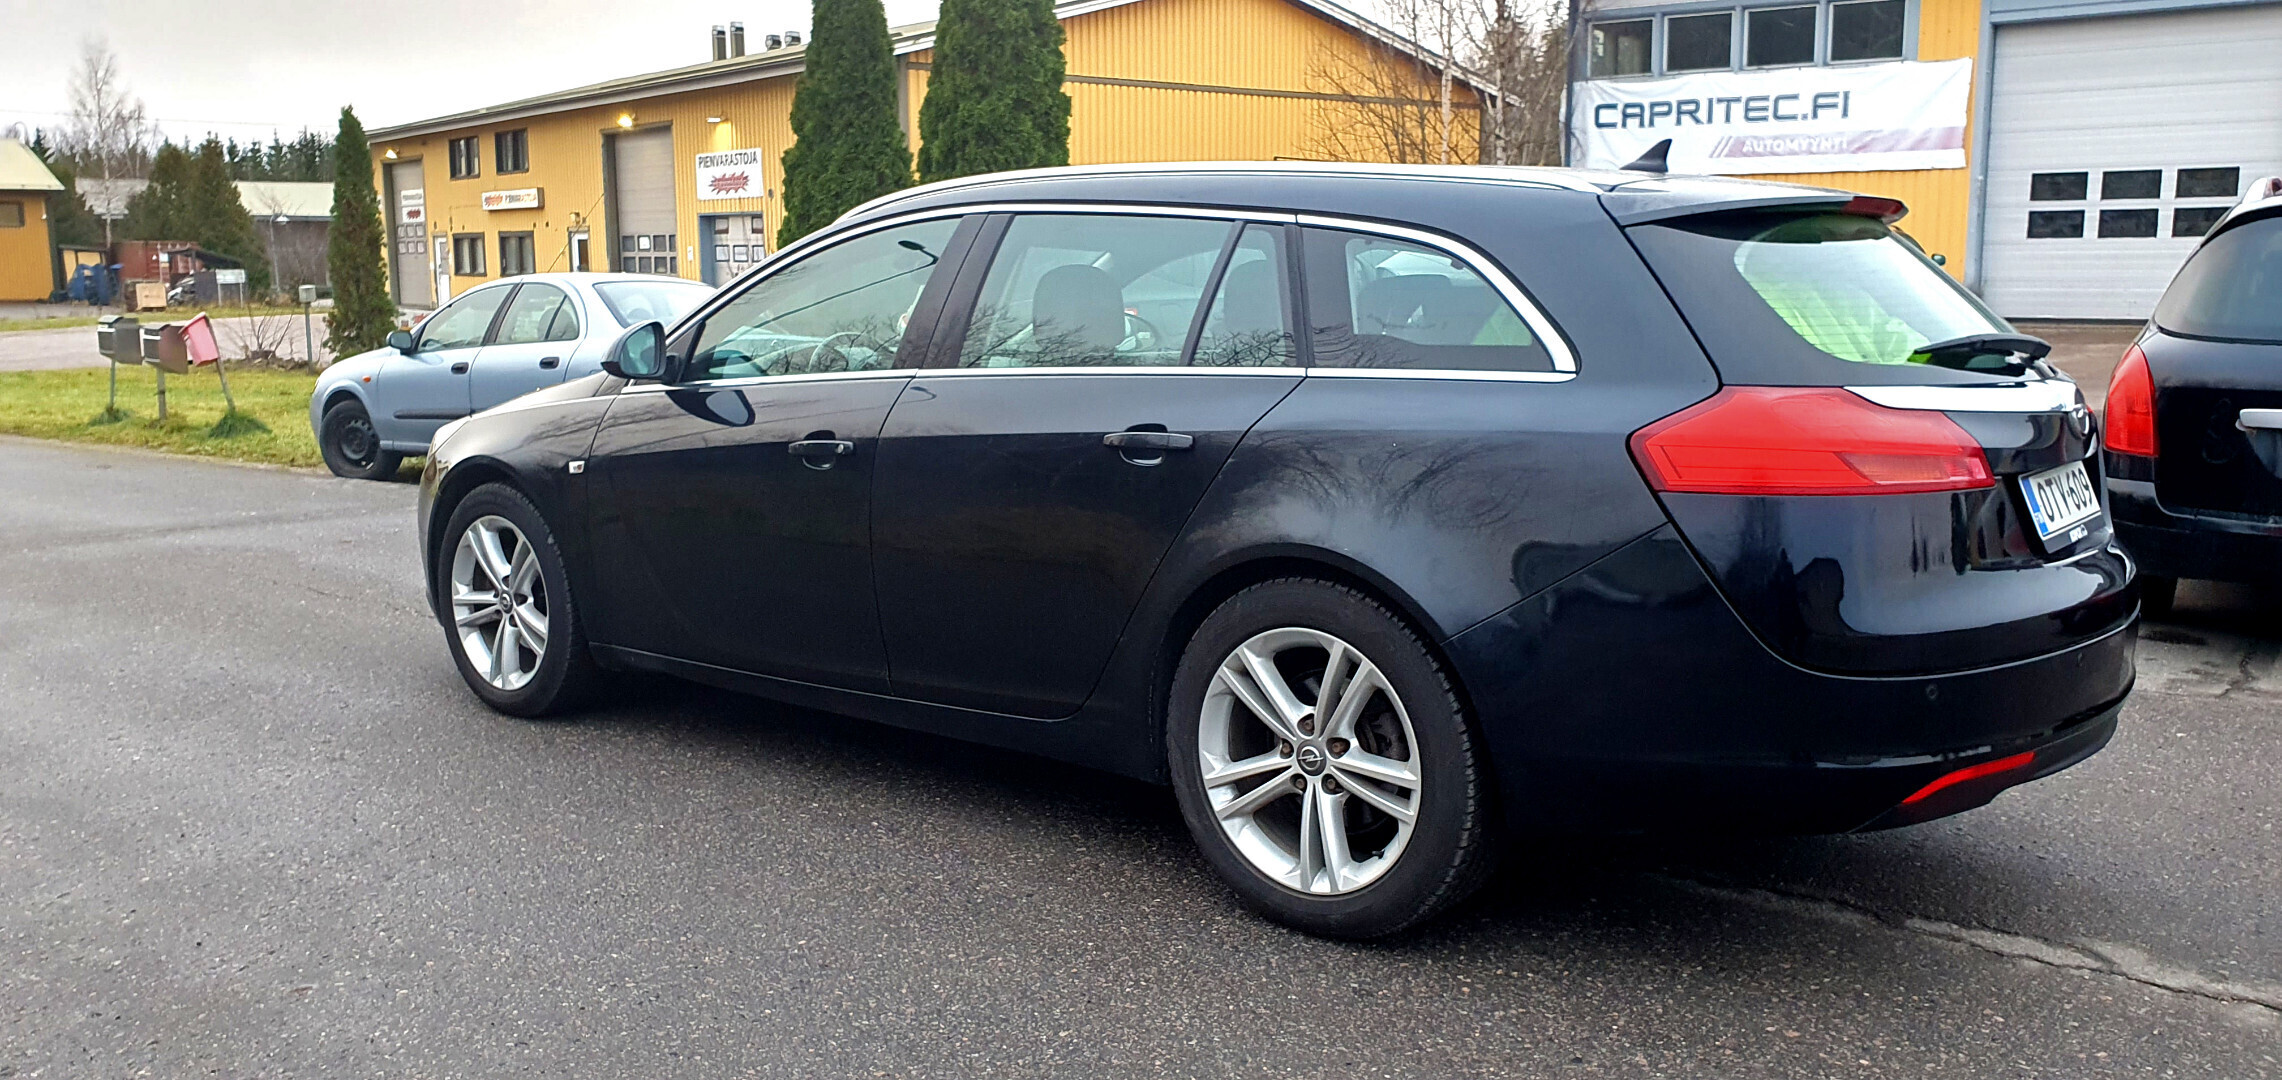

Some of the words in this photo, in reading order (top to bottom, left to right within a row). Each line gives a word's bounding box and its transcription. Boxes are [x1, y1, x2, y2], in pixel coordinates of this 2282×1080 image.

[1594, 90, 1851, 130] CAPRITEC.FI
[698, 150, 759, 169] PIENVARASTOJA
[1741, 136, 1849, 154] AUTOMYYNTI
[2037, 467, 2093, 523] OTV-609
